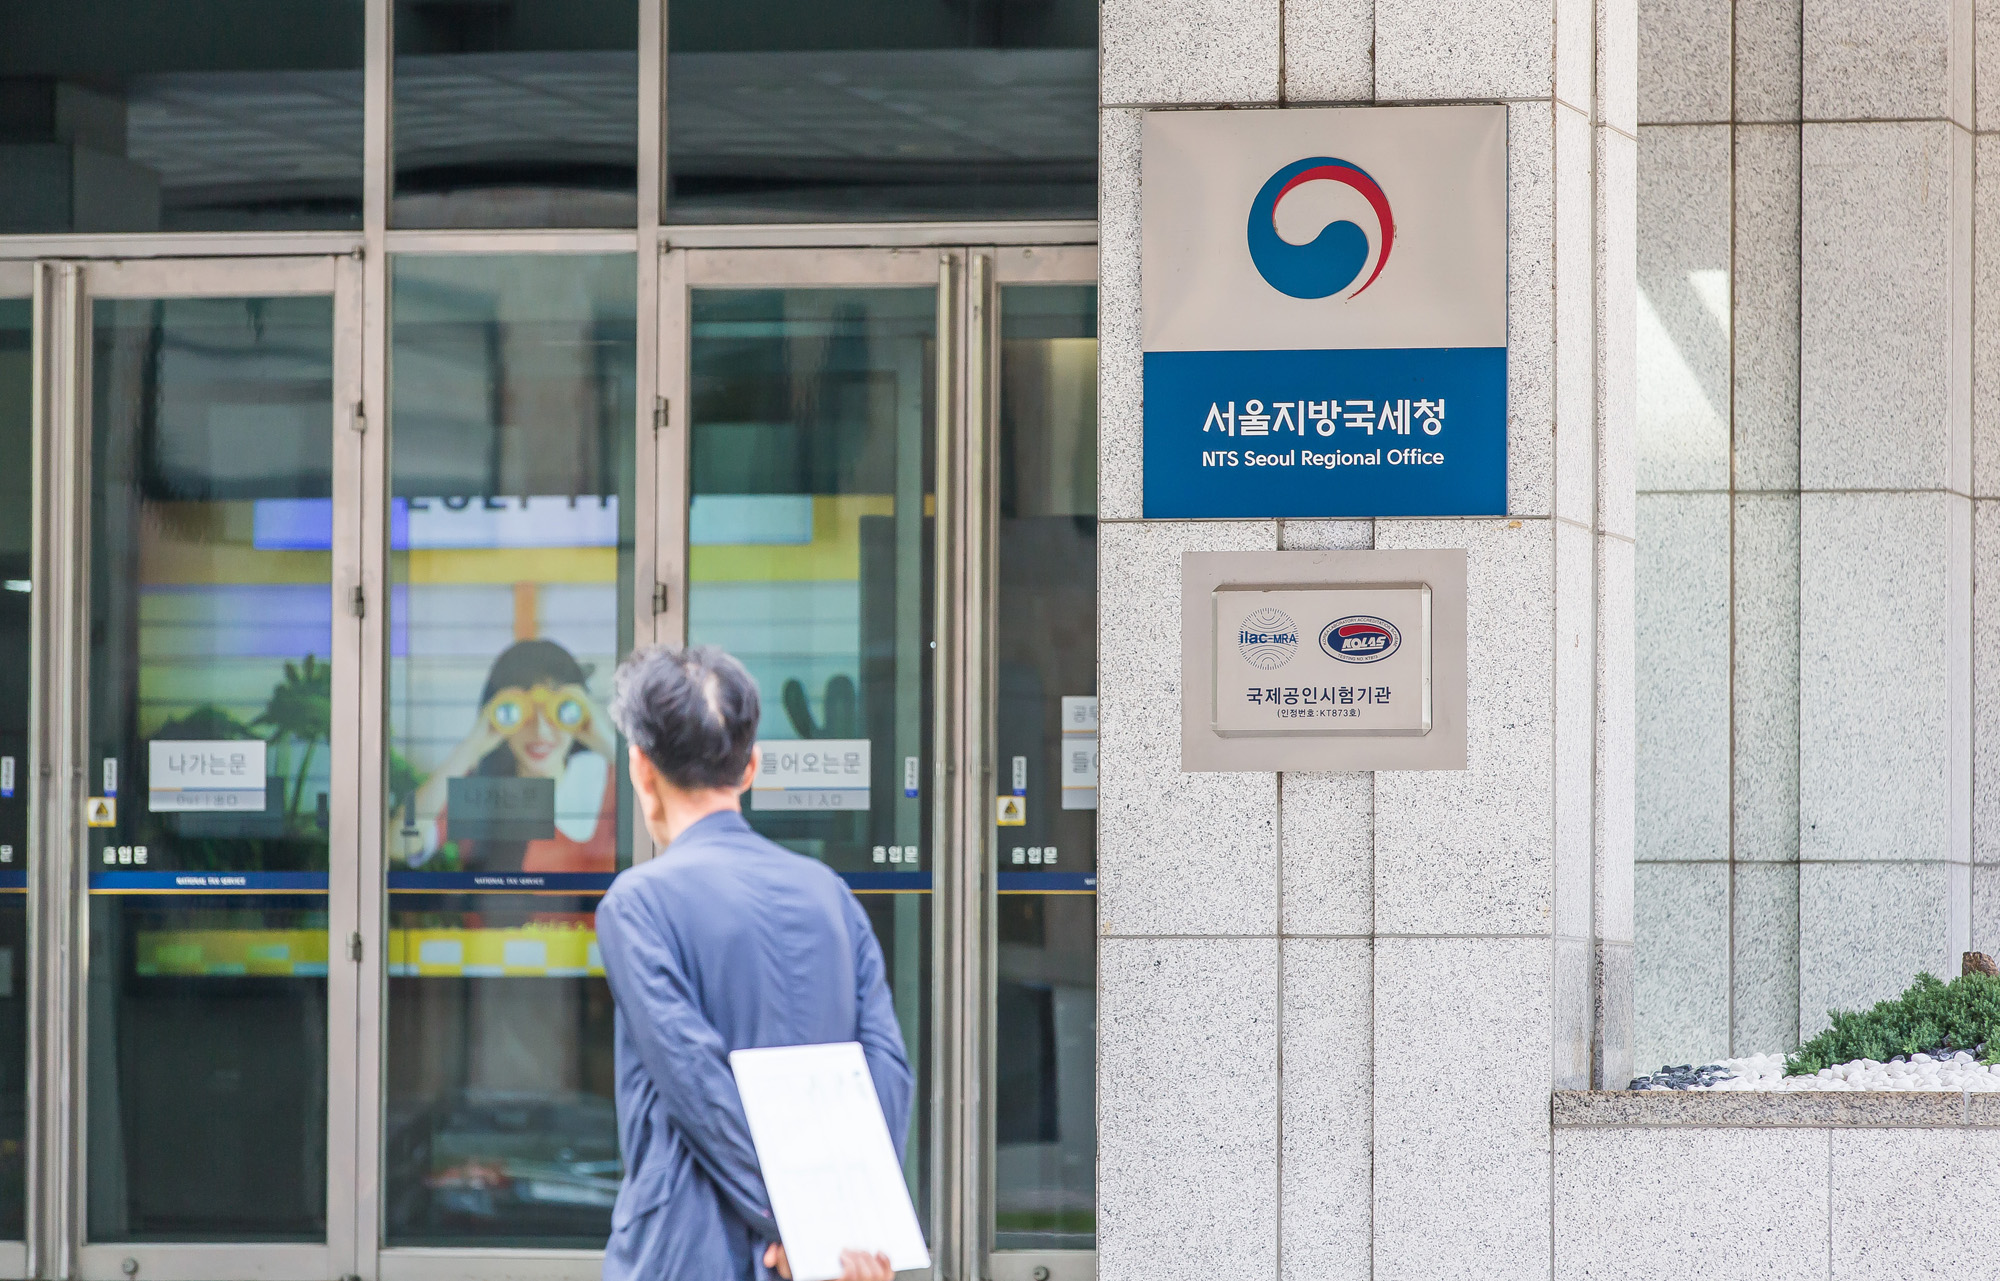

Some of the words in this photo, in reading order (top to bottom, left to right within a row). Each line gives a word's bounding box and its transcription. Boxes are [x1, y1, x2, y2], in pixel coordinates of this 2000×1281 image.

[1202, 398, 1445, 437] 서울지방국세청
[1202, 450, 1239, 467] NTS
[1244, 449, 1295, 466] Seoul
[1301, 448, 1381, 470] Regional
[1387, 448, 1445, 465] Office
[1240, 631, 1297, 644] ilac-MRA
[1342, 636, 1387, 649] KOLAS
[1246, 686, 1392, 705] 국제공인시험기관
[1277, 708, 1361, 718] (인정번호:KT873호)
[168, 752, 247, 776] 나가는문
[762, 751, 861, 775] 들어오는문
